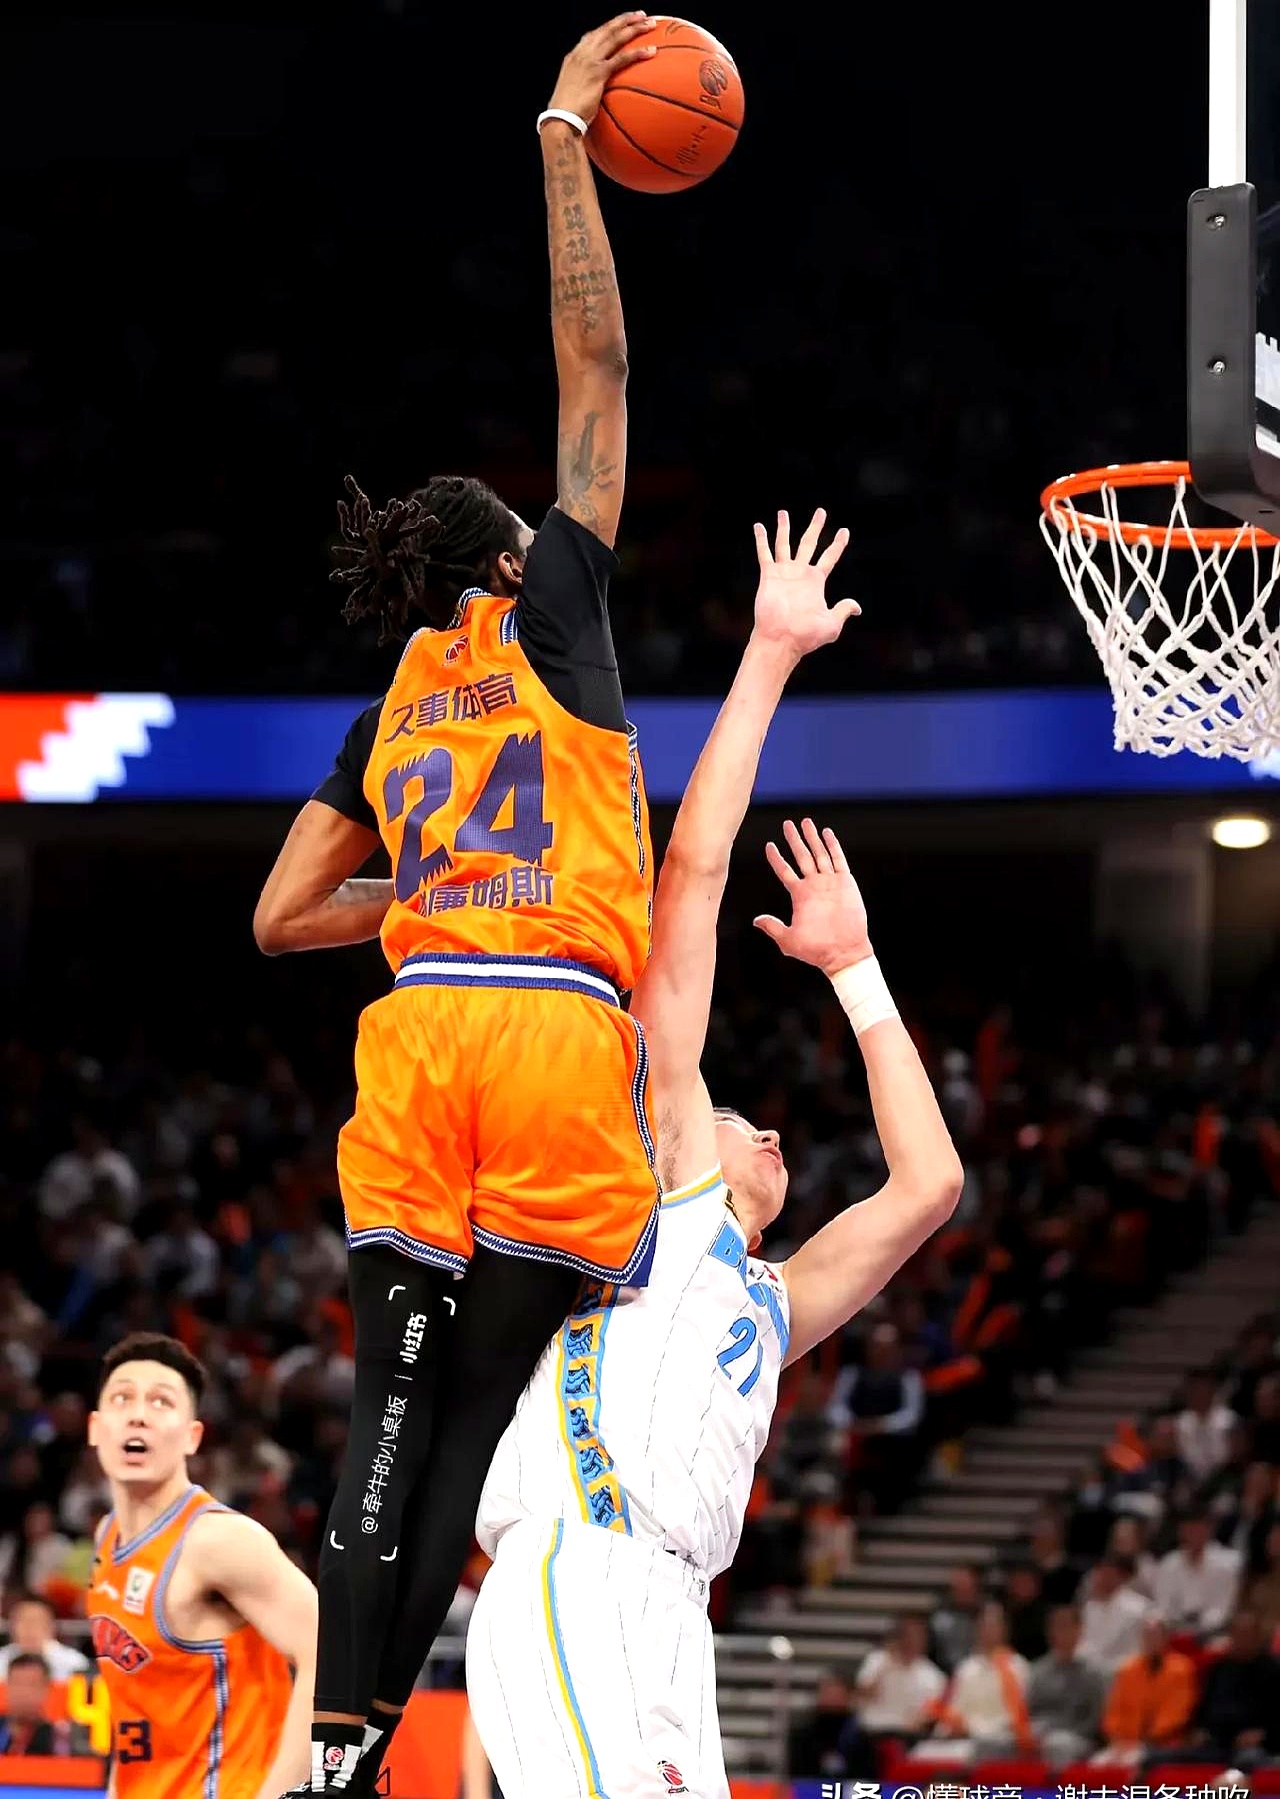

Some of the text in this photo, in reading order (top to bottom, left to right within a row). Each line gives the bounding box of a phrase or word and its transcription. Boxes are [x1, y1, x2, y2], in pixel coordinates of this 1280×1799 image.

[384, 672, 517, 743] 久事体育
[383, 729, 553, 902] 24
[417, 865, 554, 918] 廉姆斯
